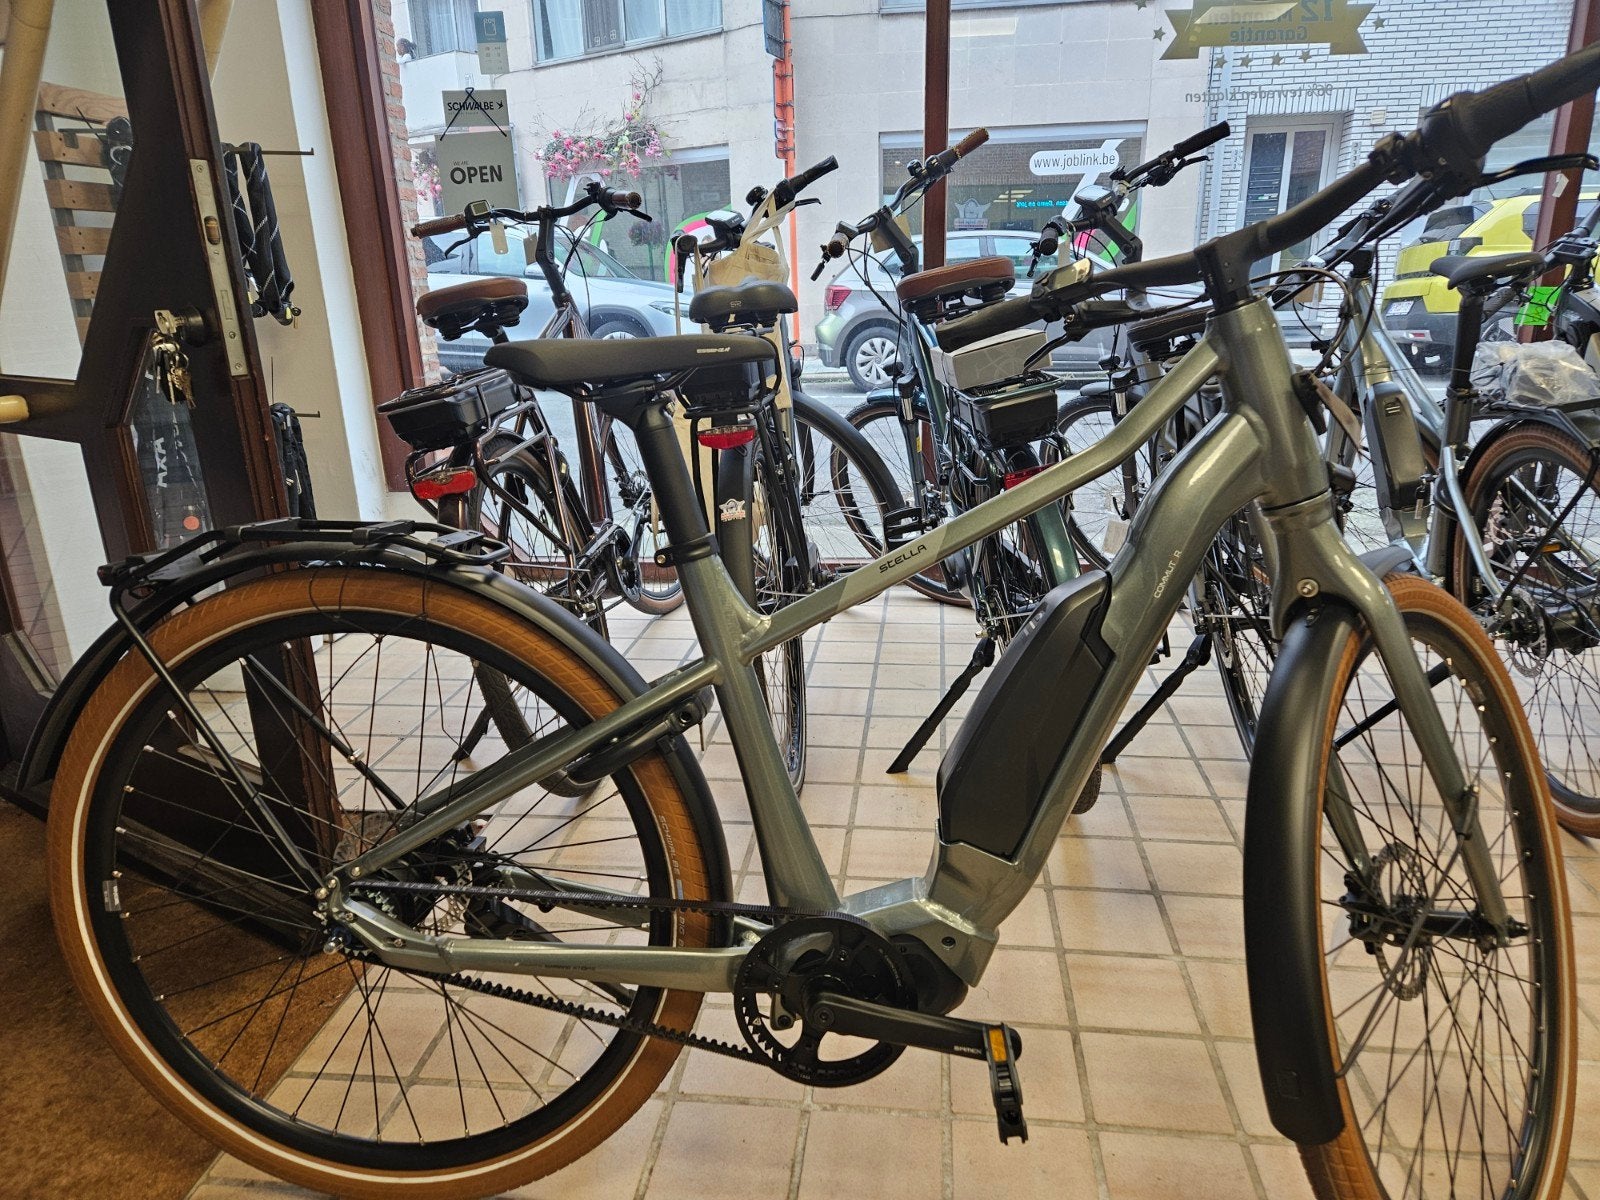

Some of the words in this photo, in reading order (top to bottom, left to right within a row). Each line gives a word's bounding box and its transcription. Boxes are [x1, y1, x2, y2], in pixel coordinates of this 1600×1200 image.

[447, 101, 495, 111] SCHWALBE
[1033, 153, 1116, 170] www.joblink.be
[450, 164, 503, 185] OPEN
[878, 544, 928, 574] STELLA
[658, 814, 681, 876] SCHWALBE
